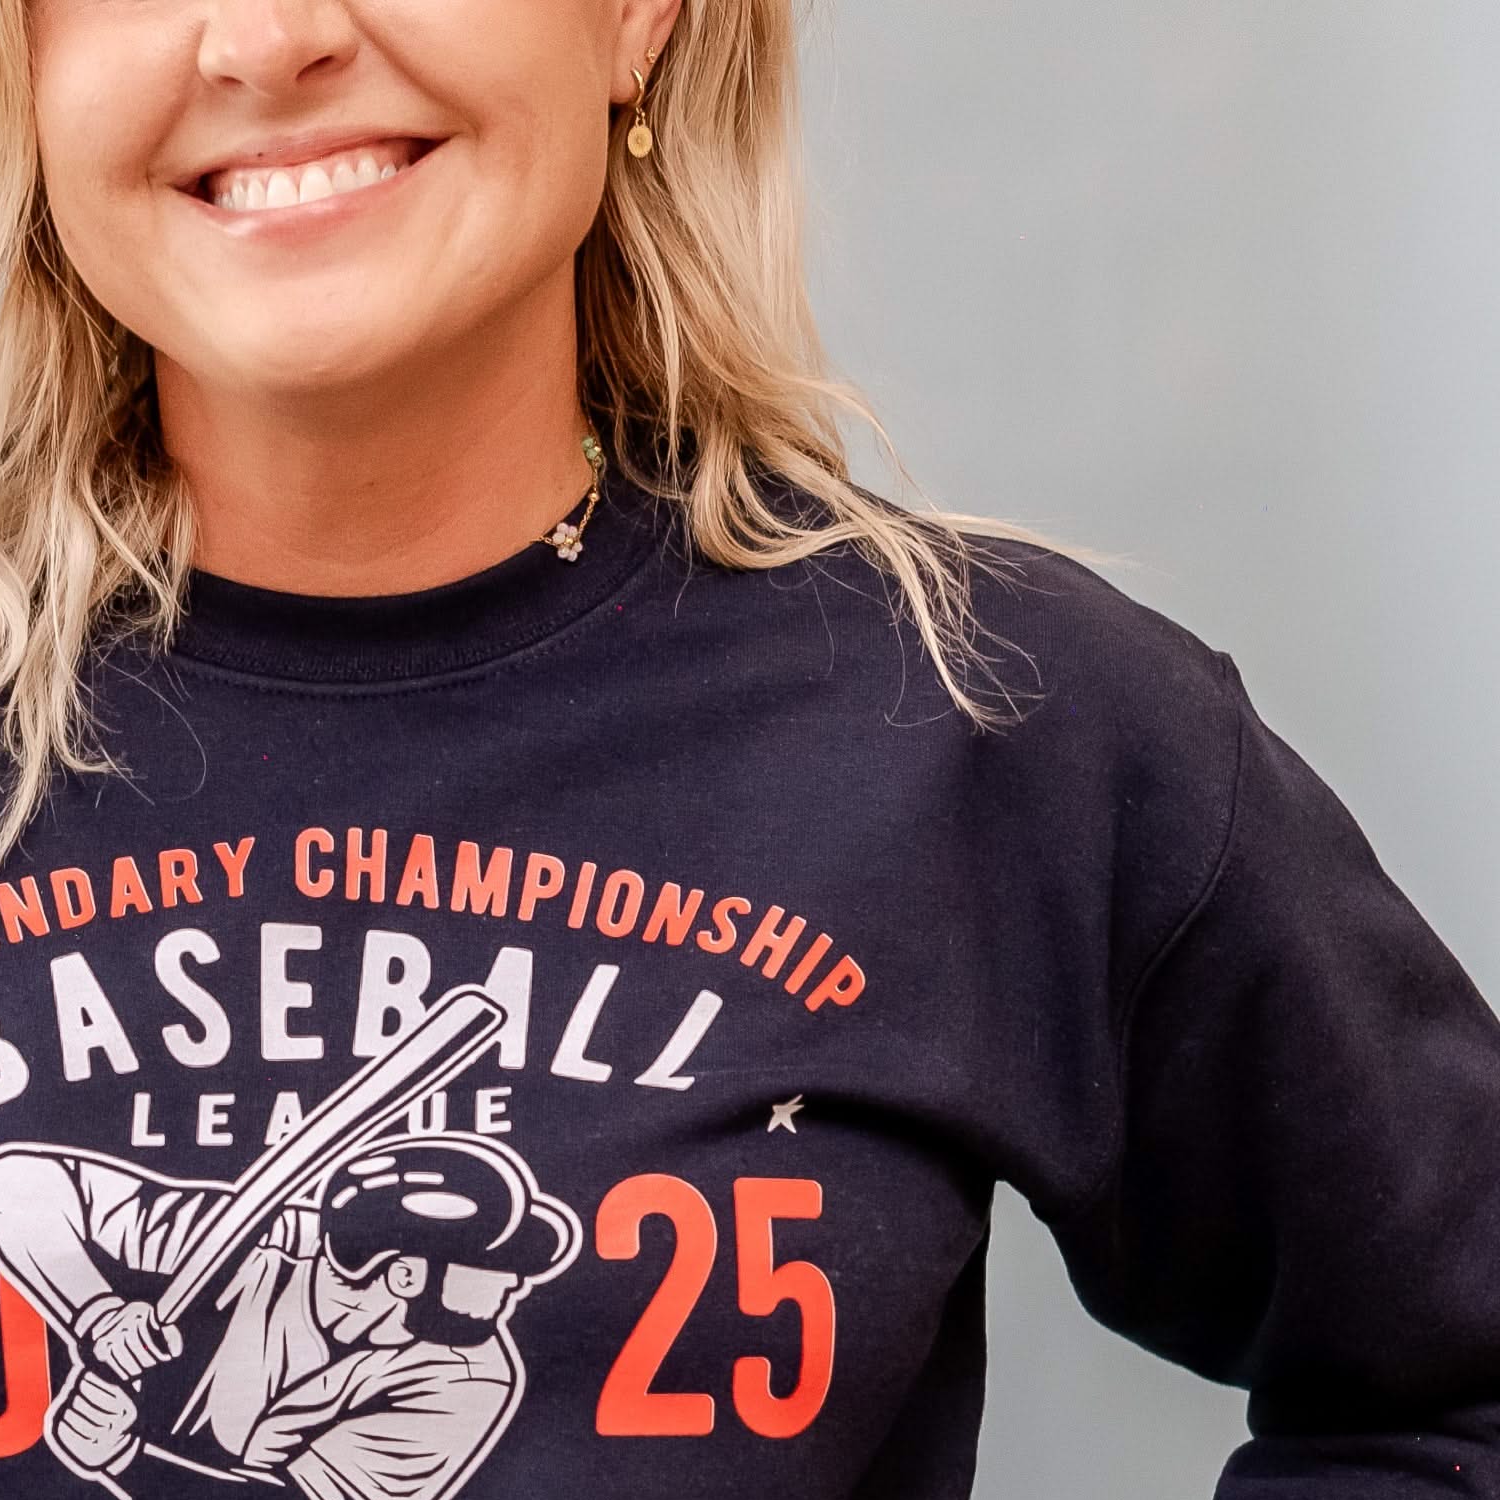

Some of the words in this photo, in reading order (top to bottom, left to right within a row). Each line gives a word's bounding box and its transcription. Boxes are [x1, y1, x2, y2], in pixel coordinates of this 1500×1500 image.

[294, 827, 866, 1013] CHAMPIONSHIP
[131, 1087, 513, 1147] LEAUE
[595, 1173, 836, 1439] 25
